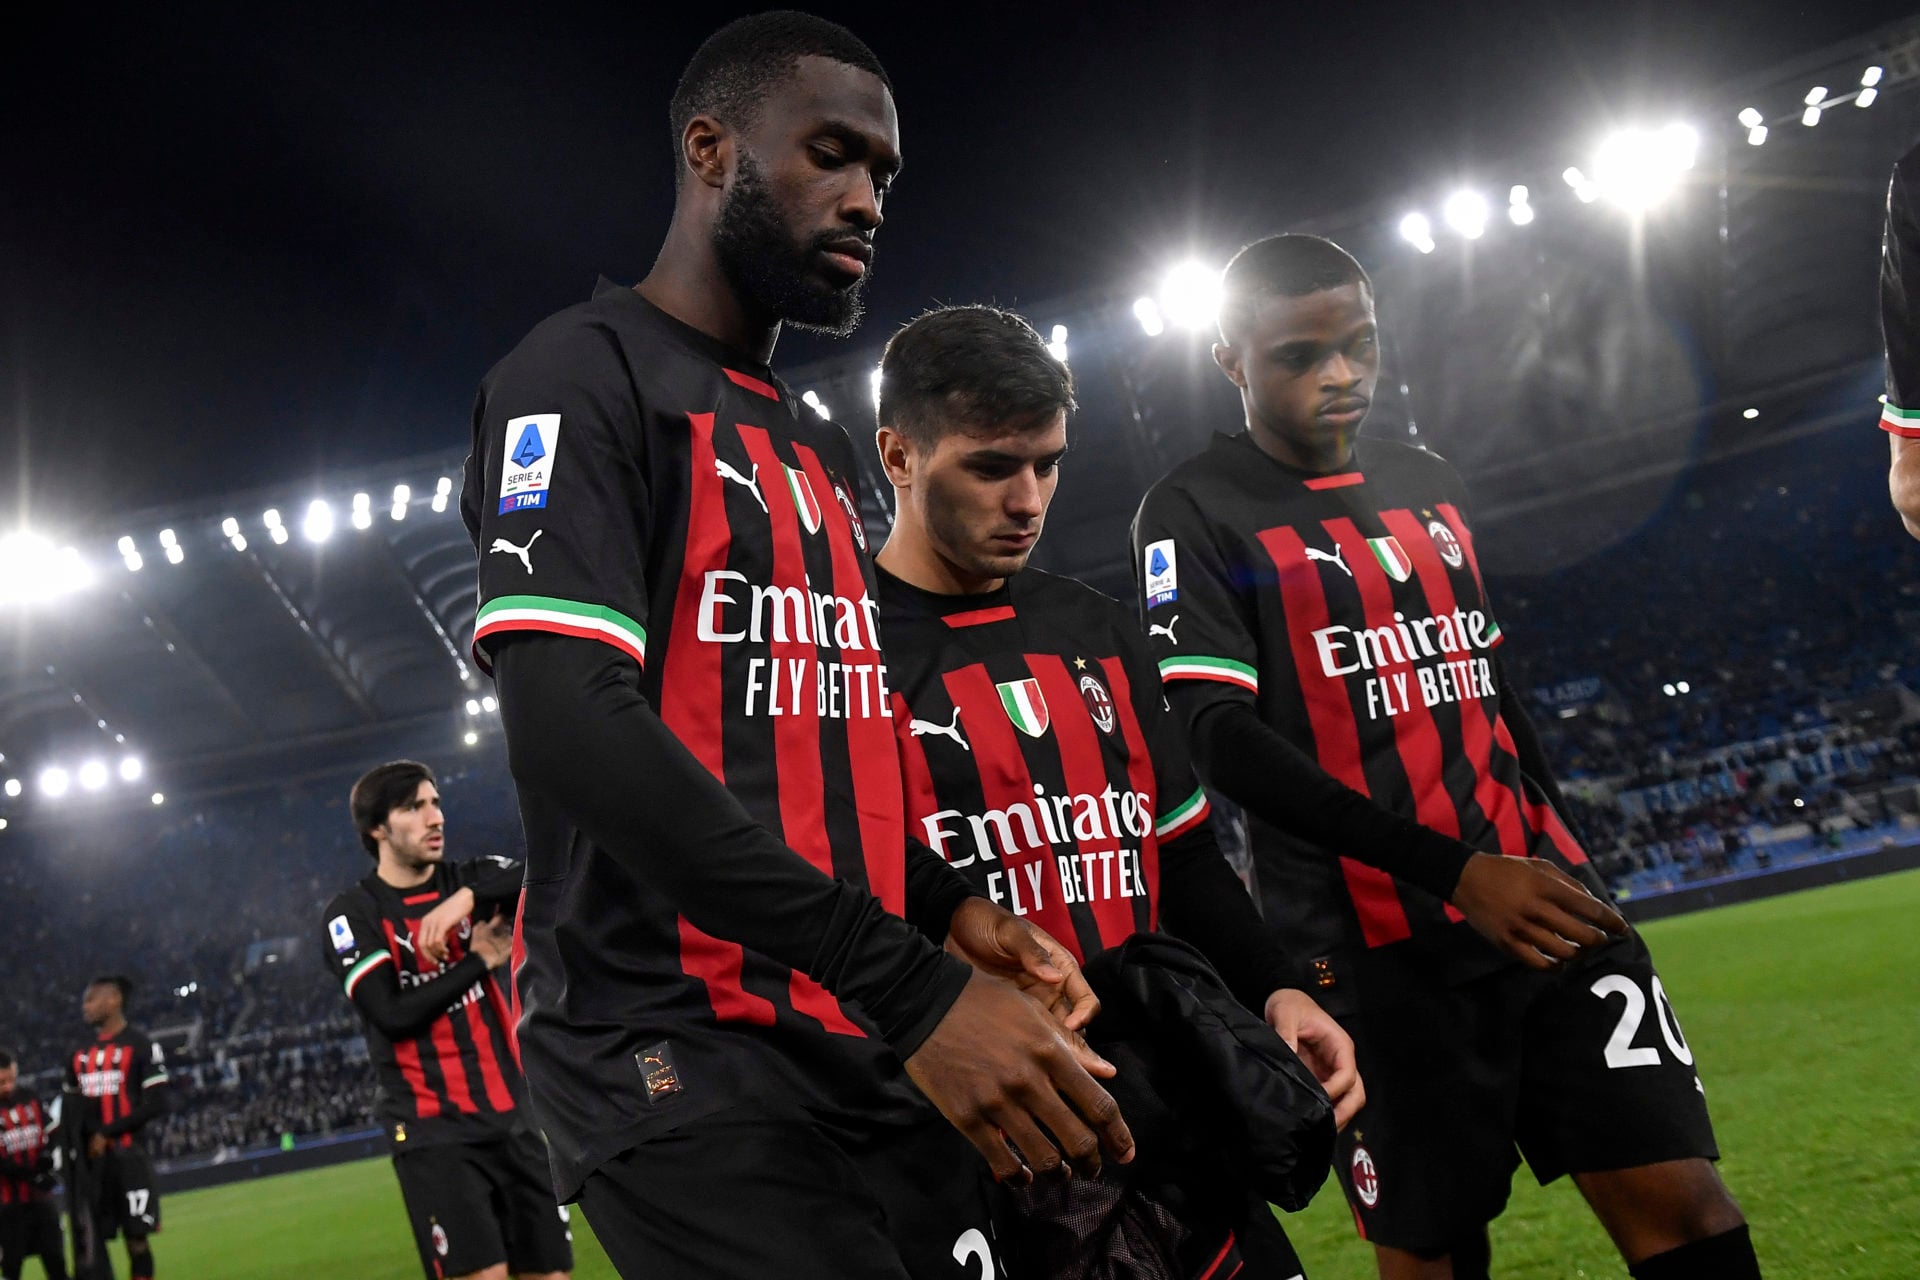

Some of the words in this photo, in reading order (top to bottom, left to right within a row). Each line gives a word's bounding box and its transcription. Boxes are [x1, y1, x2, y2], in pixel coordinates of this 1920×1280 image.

[507, 471, 533, 486] SERIE
[535, 471, 543, 480] A
[516, 493, 541, 507] TIM
[697, 570, 881, 651] Emirat
[1156, 591, 1173, 603] TIM
[1311, 605, 1490, 678] Emirate
[745, 658, 806, 717] FLY
[817, 660, 893, 719] BETTE
[1366, 672, 1410, 720] FLY
[1416, 657, 1496, 708] BETTER
[920, 782, 1153, 869] Emirates
[986, 860, 1042, 916] FLY
[1058, 849, 1146, 904] BETTER
[1590, 974, 1693, 1069] 20
[126, 1188, 150, 1217] 17
